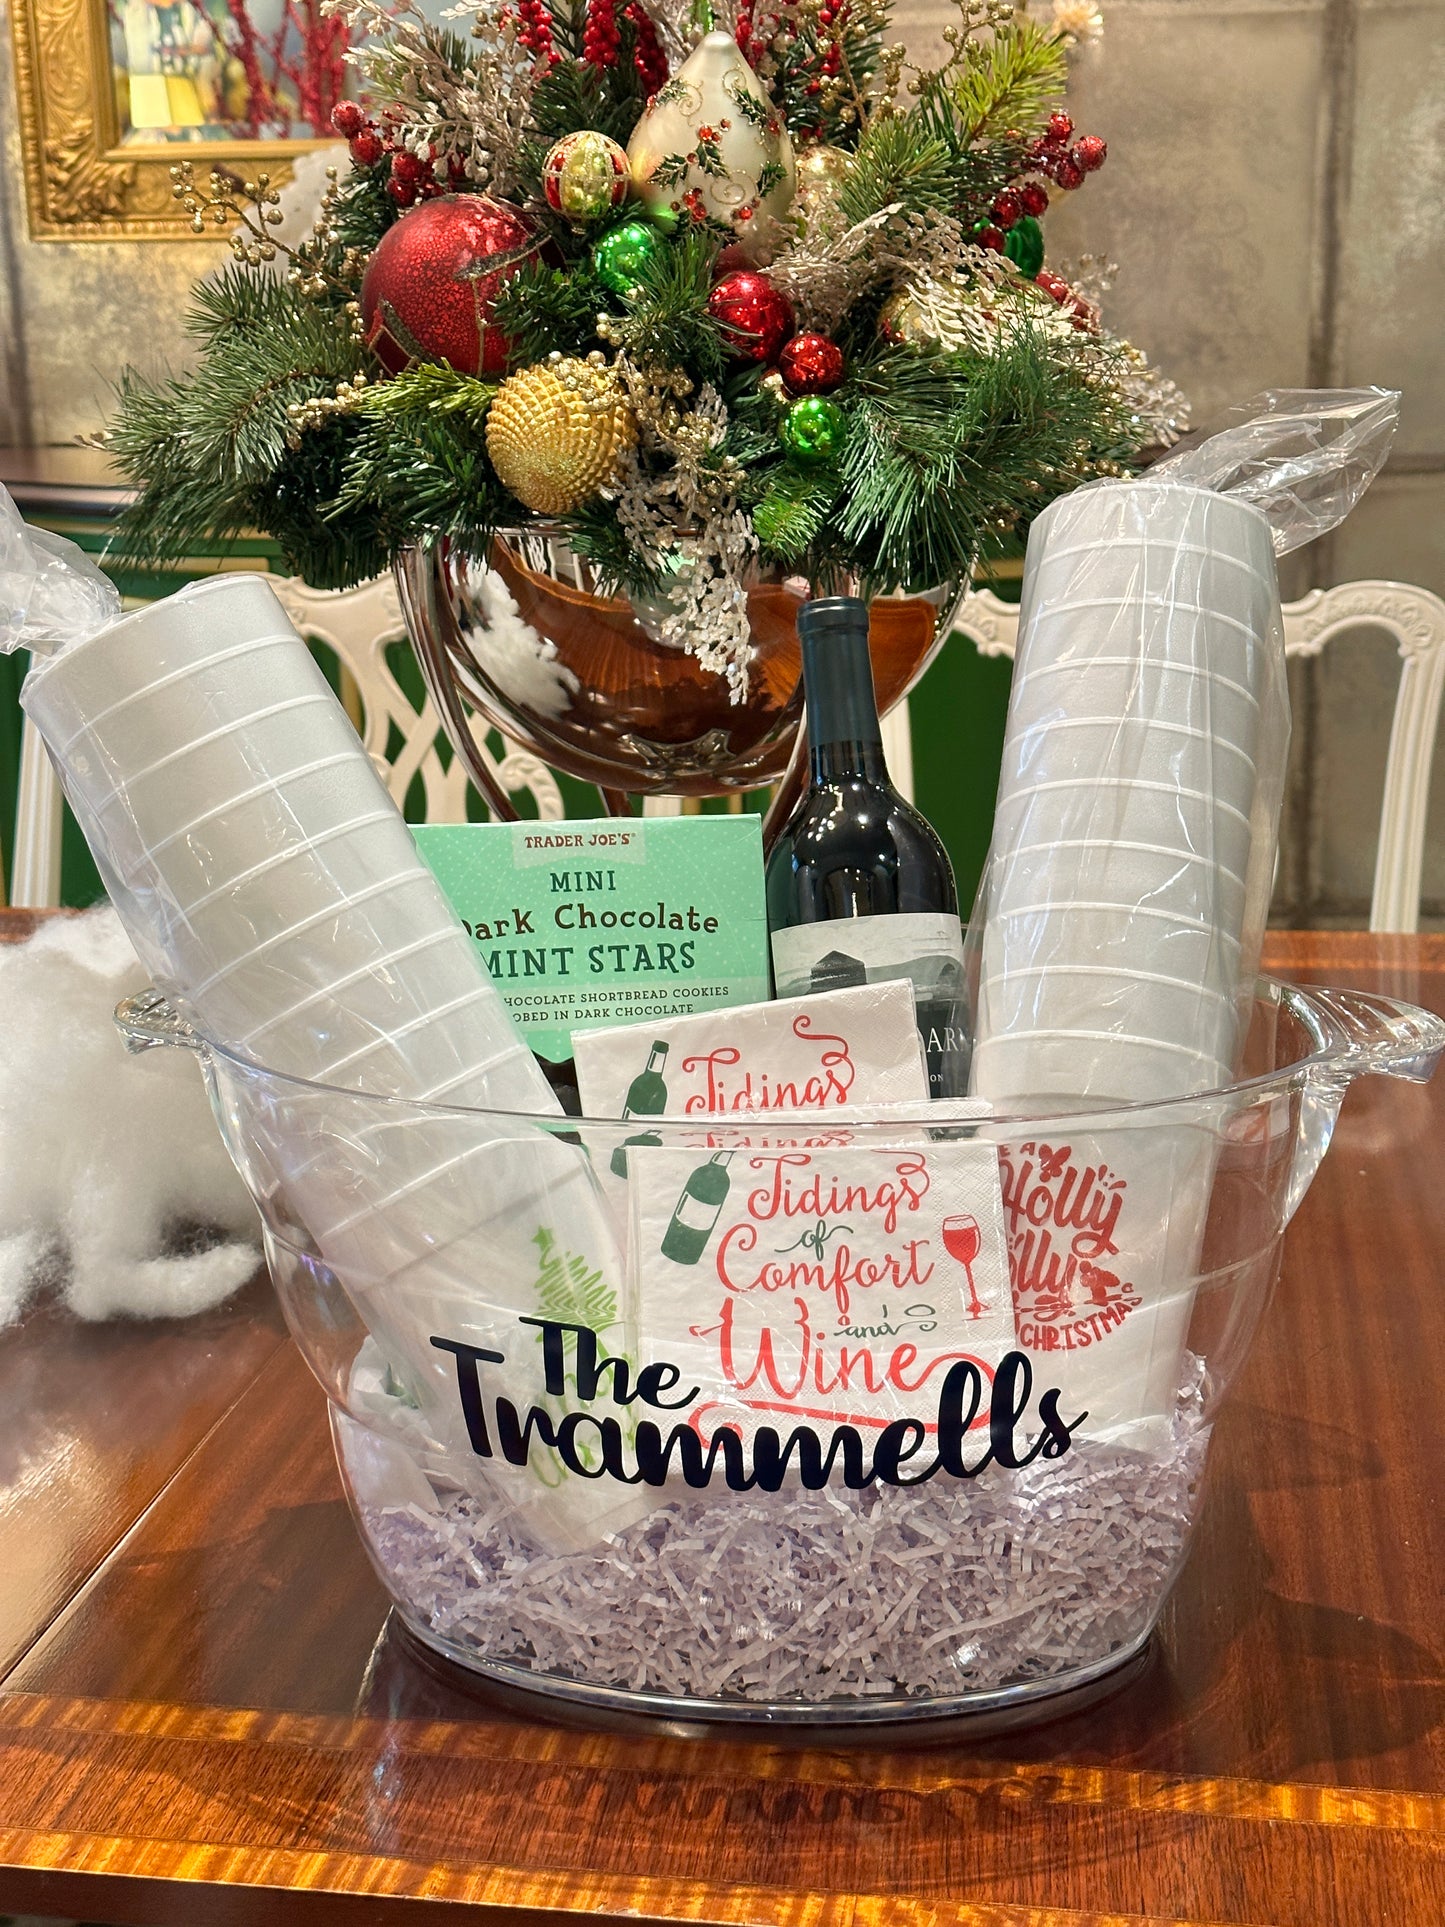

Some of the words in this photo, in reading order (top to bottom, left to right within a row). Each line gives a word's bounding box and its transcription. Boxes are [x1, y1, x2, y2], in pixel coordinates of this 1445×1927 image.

[524, 834, 585, 849] TRADER
[588, 832, 631, 847] JOE'S
[549, 870, 617, 893] MINI
[554, 902, 719, 934] Chocolate
[588, 940, 696, 974] STARS
[504, 994, 576, 1007] HOCOLATE
[580, 989, 668, 1004] SHORTBREAD
[672, 986, 730, 998] COOKIES
[512, 1010, 549, 1023] OBED
[554, 1010, 569, 1020] IN
[574, 1008, 611, 1019] DARK
[615, 1003, 694, 1017] CHOCOLATE
[682, 1015, 856, 1115] Tidings
[747, 1150, 931, 1235] Tidings
[998, 1160, 1124, 1260] Holly
[774, 1219, 854, 1262] of
[715, 1222, 936, 1320] Comfort
[833, 1303, 938, 1339] and
[518, 1315, 701, 1410] The
[688, 1296, 980, 1402] Wine
[429, 1335, 1089, 1492] Trammells
